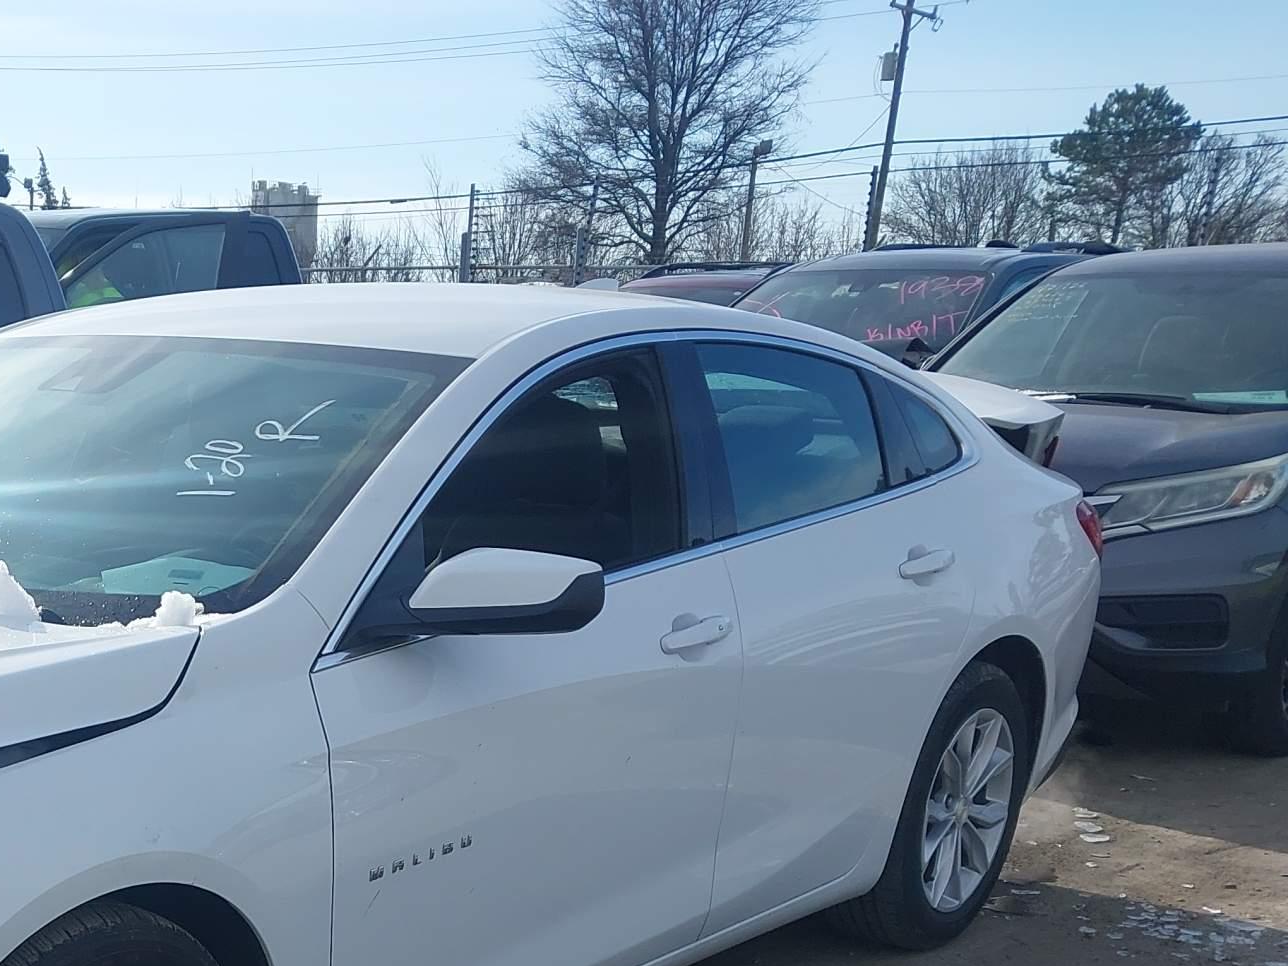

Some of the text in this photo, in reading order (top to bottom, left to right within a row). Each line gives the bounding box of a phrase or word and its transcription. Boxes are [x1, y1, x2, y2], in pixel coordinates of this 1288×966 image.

[175, 399, 337, 496] 1-20 R
[368, 834, 473, 882] MALIBU
